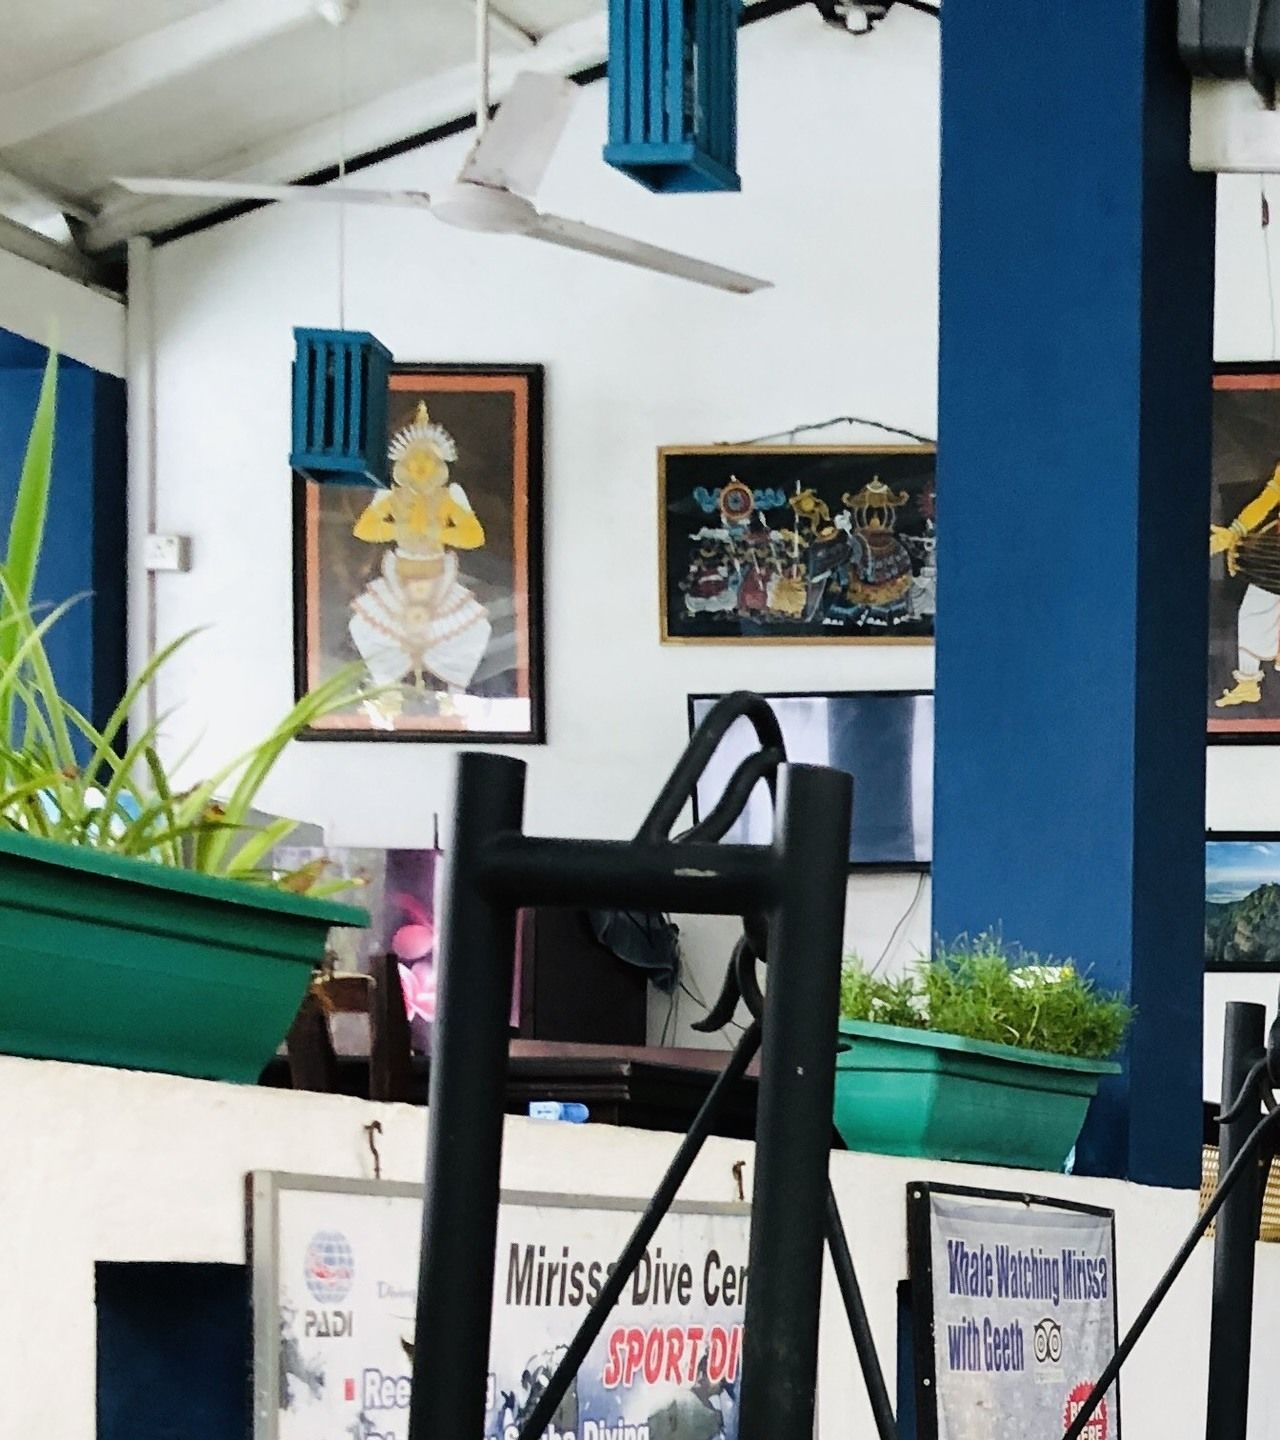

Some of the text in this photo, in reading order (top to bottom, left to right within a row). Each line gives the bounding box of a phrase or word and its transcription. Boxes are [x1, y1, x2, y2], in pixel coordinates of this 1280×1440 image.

[505, 1242, 619, 1307] Miriss
[631, 1247, 693, 1306] Dive
[995, 1244, 1060, 1307] Watching
[1061, 1249, 1108, 1301] Mirissa
[304, 1309, 354, 1338] PADI
[947, 1316, 1025, 1372] with Geeth
[603, 1325, 704, 1388] SPORT
[363, 1367, 413, 1410] Ree
